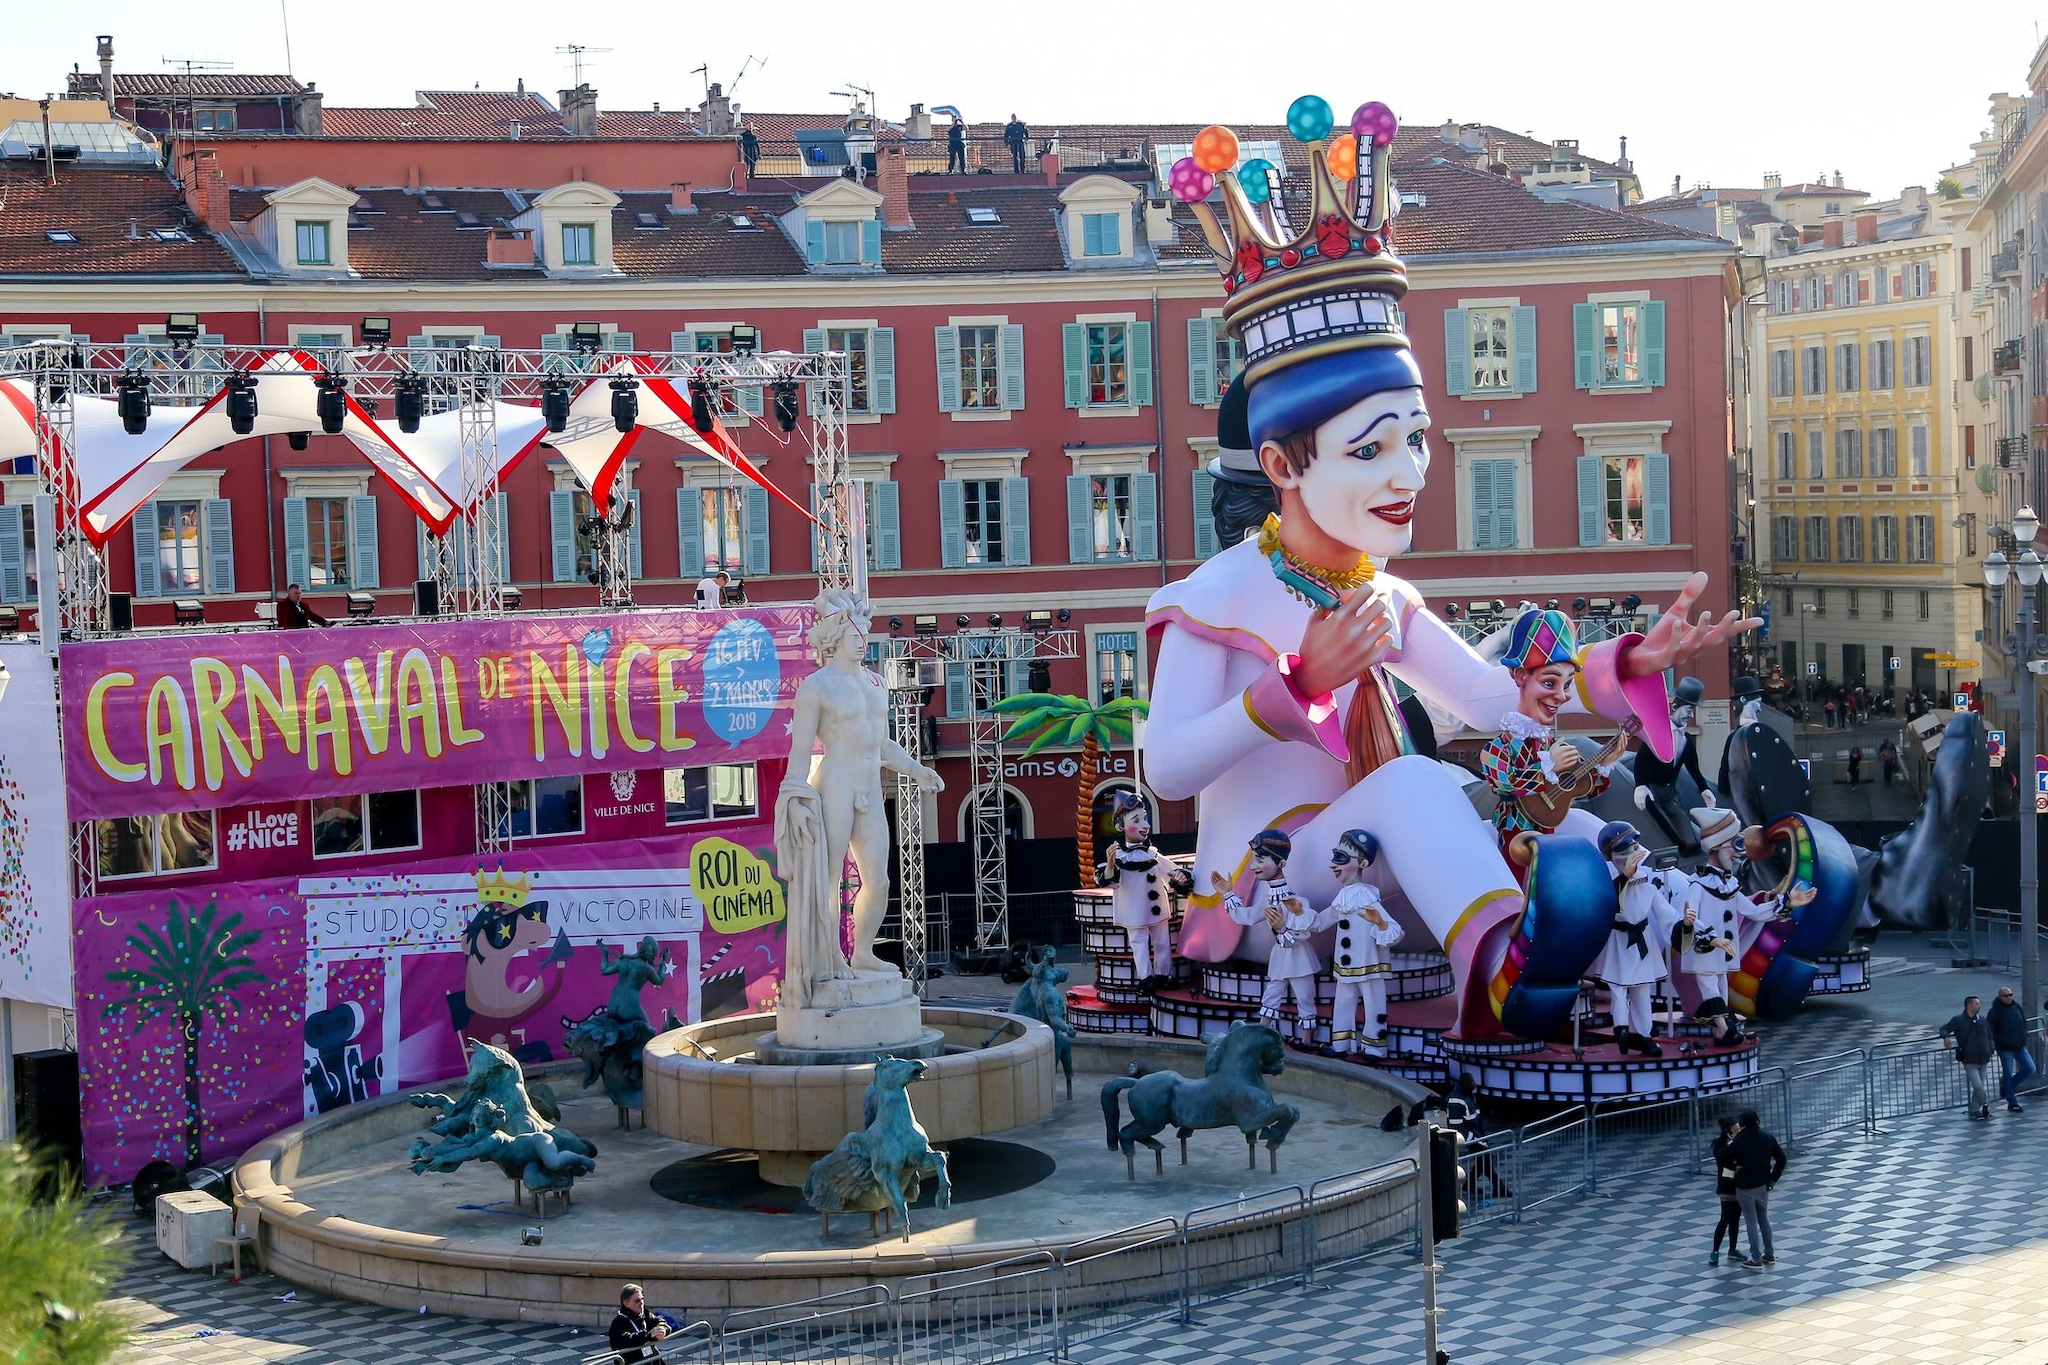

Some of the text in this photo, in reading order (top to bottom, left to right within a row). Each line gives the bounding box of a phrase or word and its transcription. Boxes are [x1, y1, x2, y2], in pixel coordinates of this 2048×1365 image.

[714, 639, 733, 664] 16
[1098, 634, 1136, 650] HOTEL
[710, 679, 774, 707] 2 MARS
[86, 648, 485, 791] CARNAVAL
[478, 657, 514, 699] DE
[728, 711, 757, 732] 2019
[594, 803, 656, 817] VILLE DE NICE
[698, 849, 761, 890] ROI DU
[325, 905, 448, 935] STUDIOS
[559, 896, 693, 924] VICTORINE
[713, 888, 774, 922] CINÉMA
